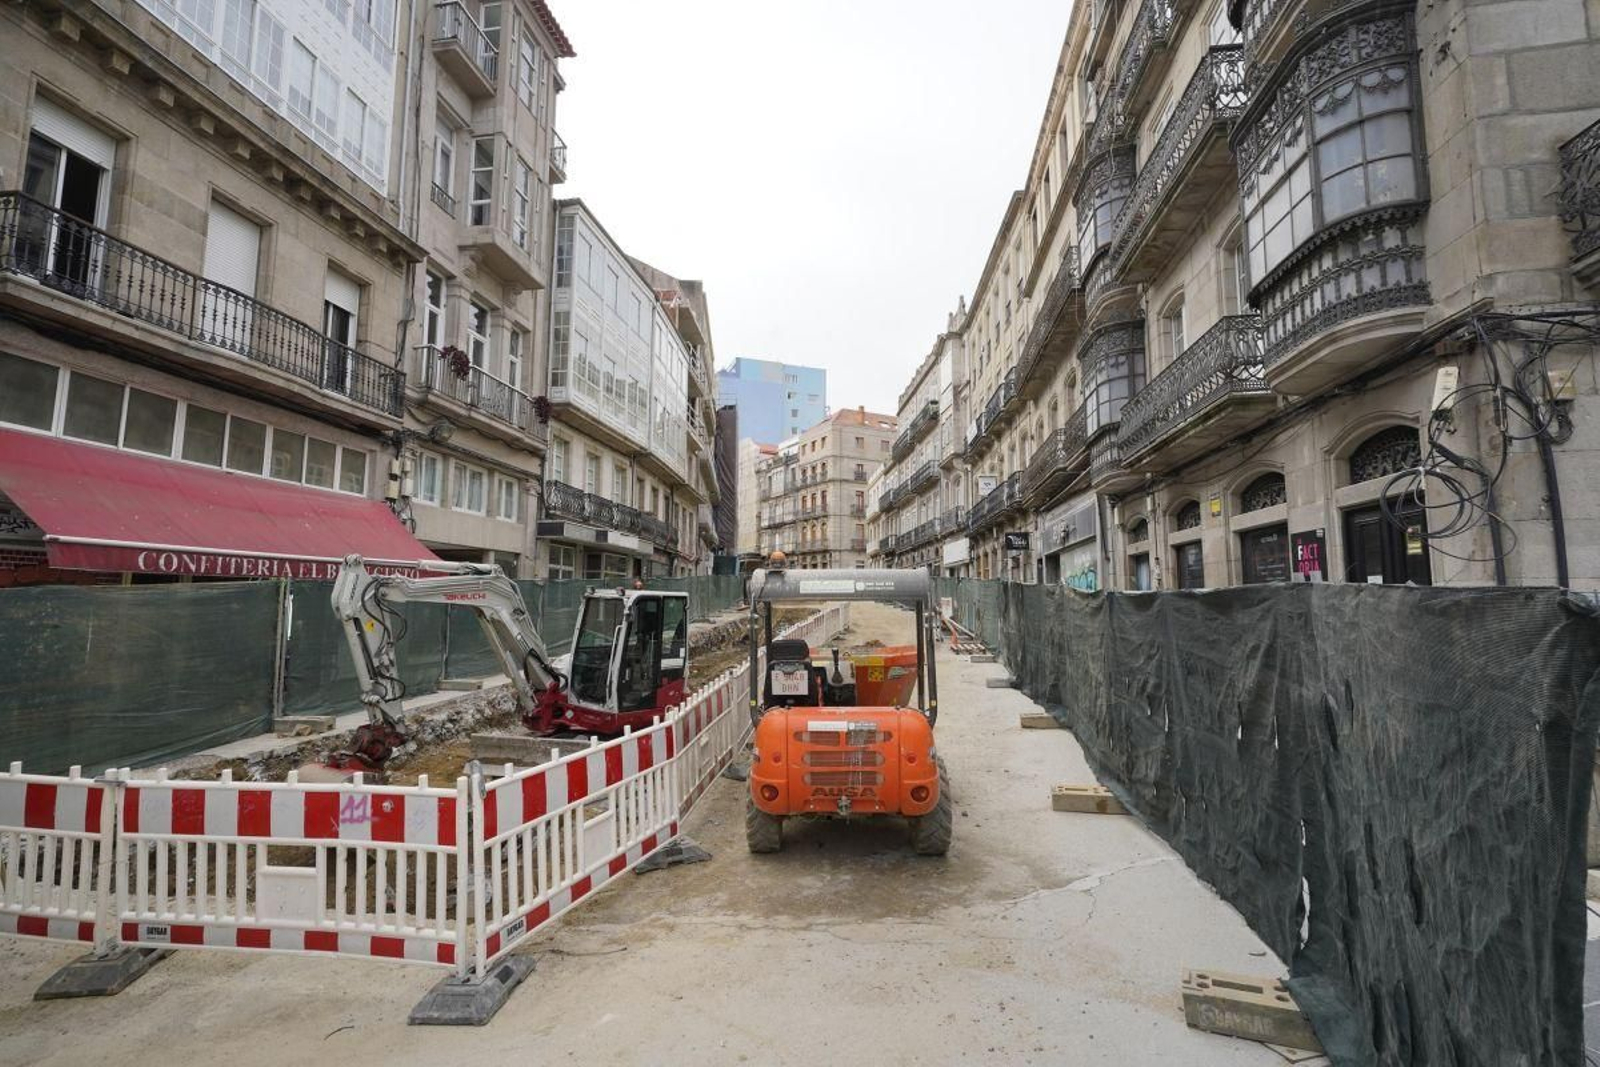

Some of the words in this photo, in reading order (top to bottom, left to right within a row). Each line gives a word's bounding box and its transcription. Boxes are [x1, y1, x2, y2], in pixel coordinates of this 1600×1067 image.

[1297, 543, 1319, 561] FACT
[138, 551, 293, 577] CONFITERIA
[300, 562, 322, 578] EL
[811, 787, 877, 797] AUSA
